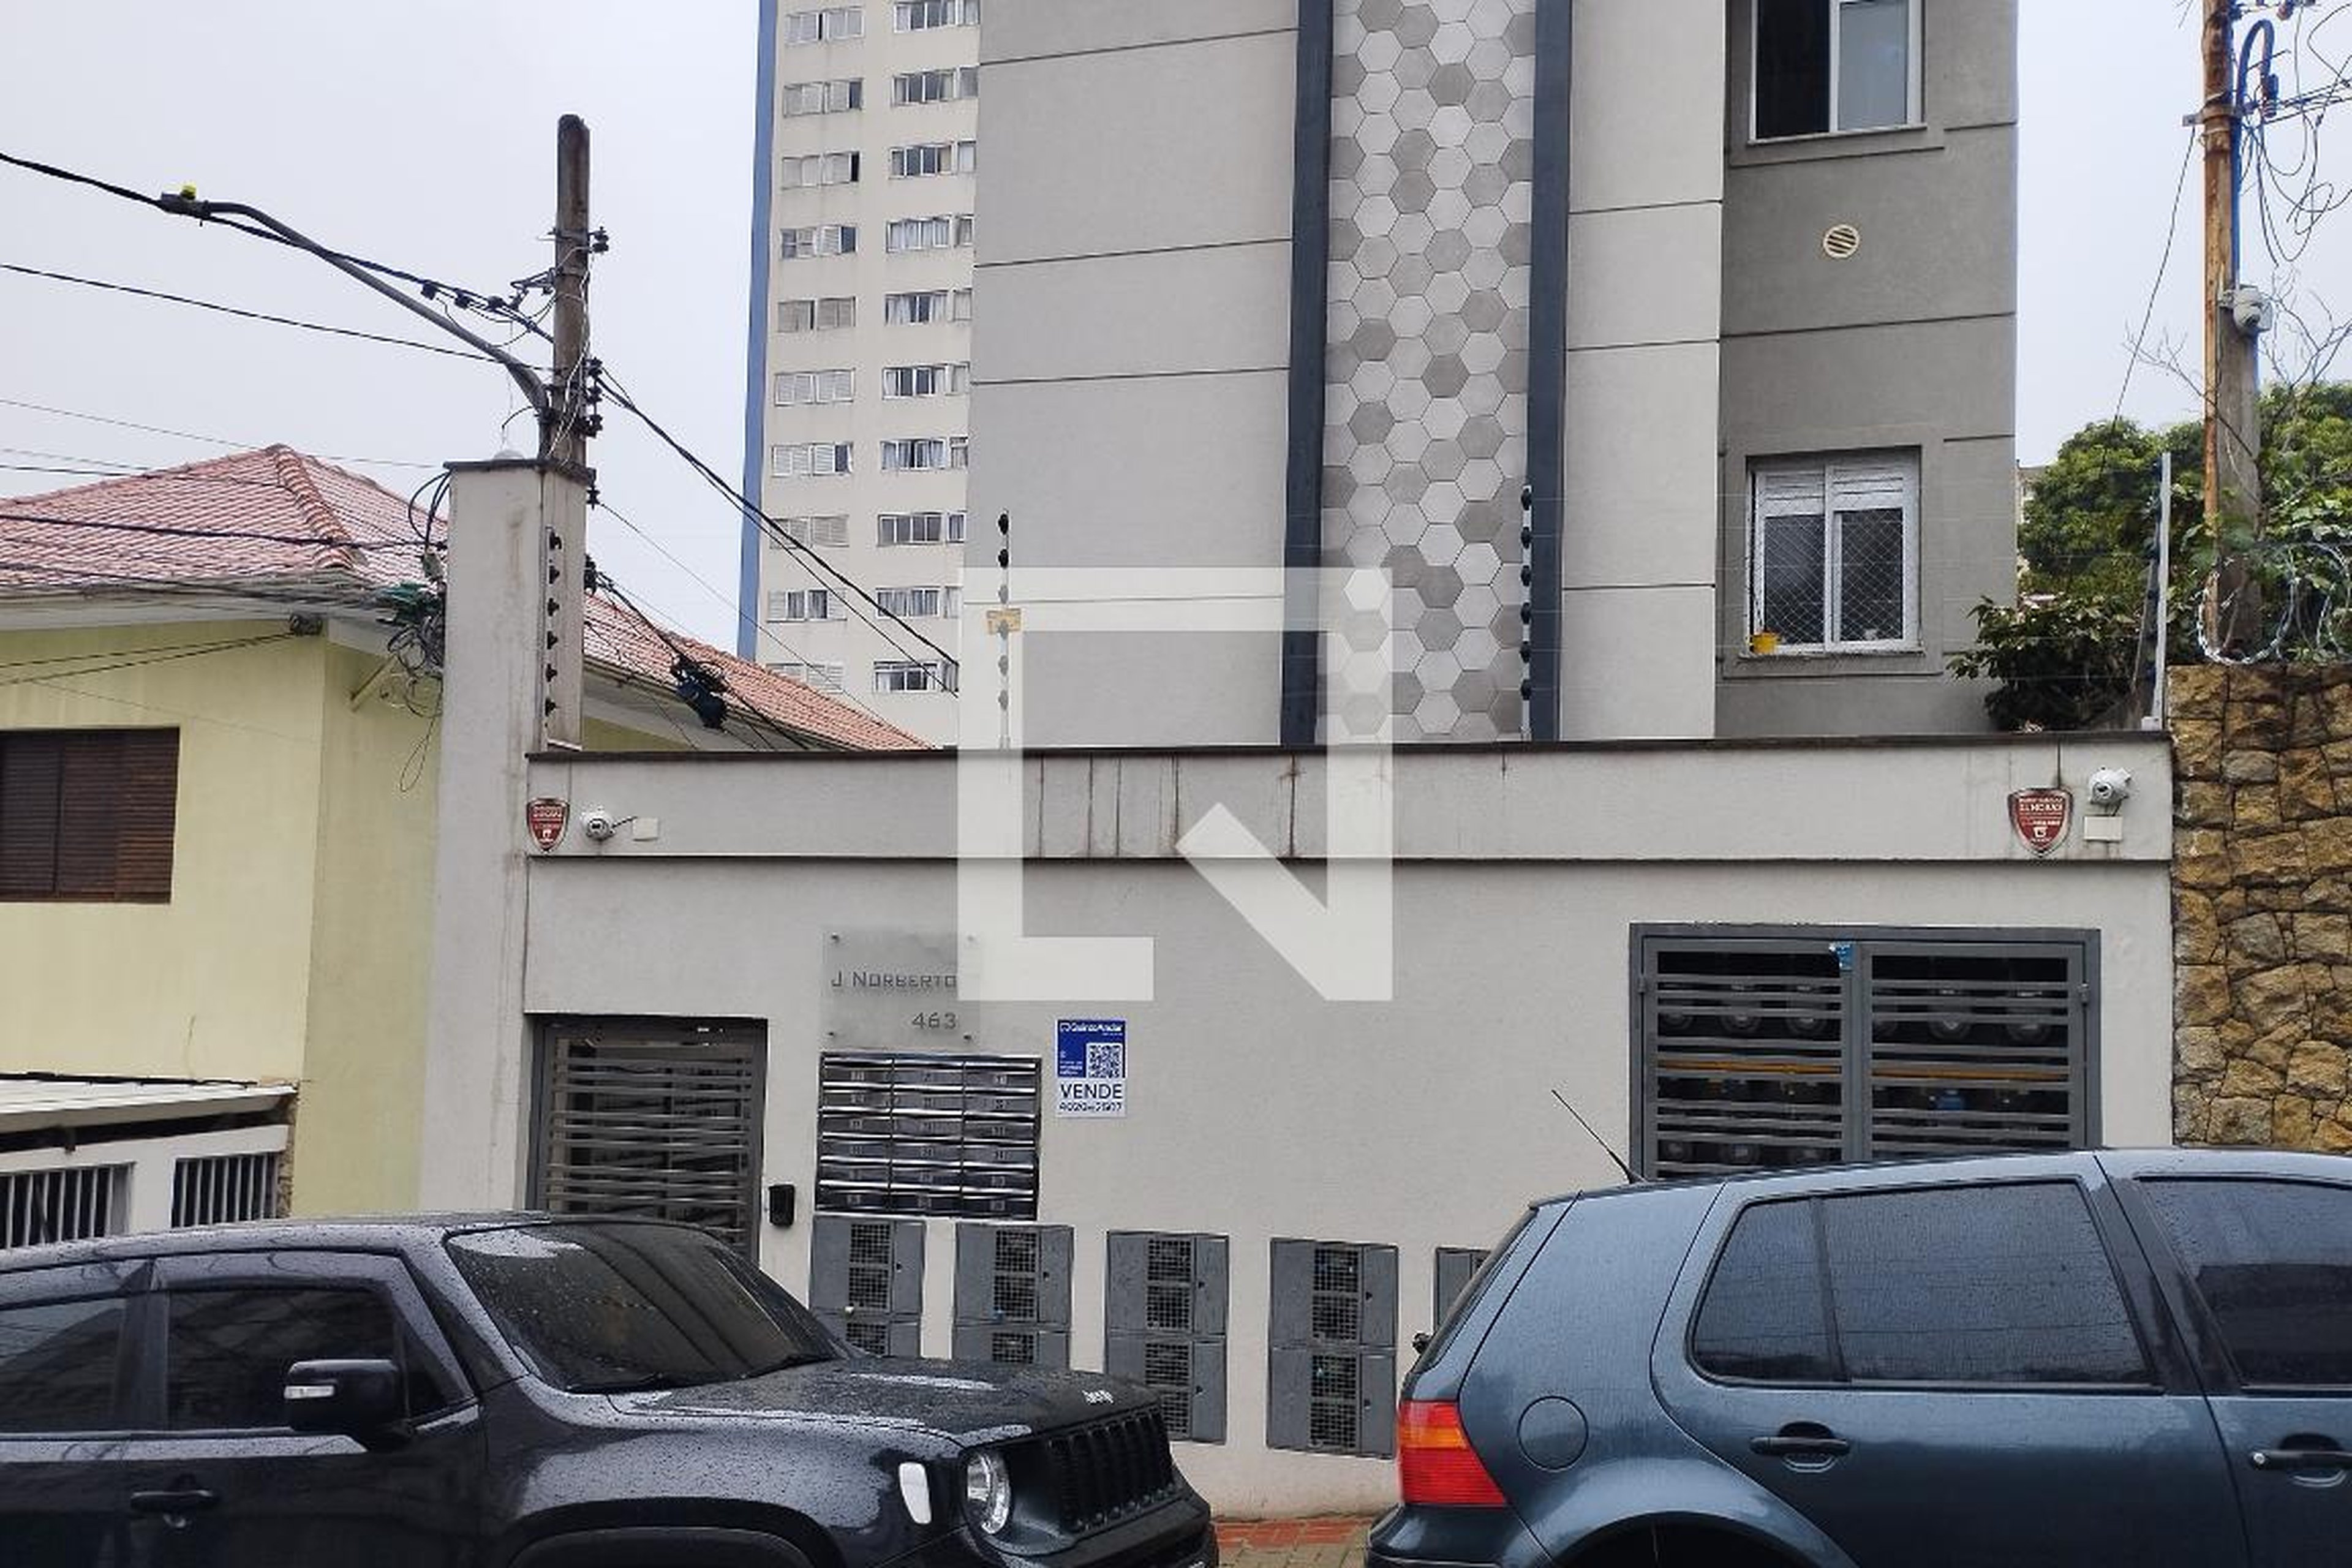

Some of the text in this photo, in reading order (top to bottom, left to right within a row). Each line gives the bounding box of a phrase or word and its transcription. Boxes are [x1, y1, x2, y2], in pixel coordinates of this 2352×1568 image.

[831, 970, 842, 987] J
[911, 1012, 957, 1030] 463
[1060, 1084, 1123, 1099] VENDE
